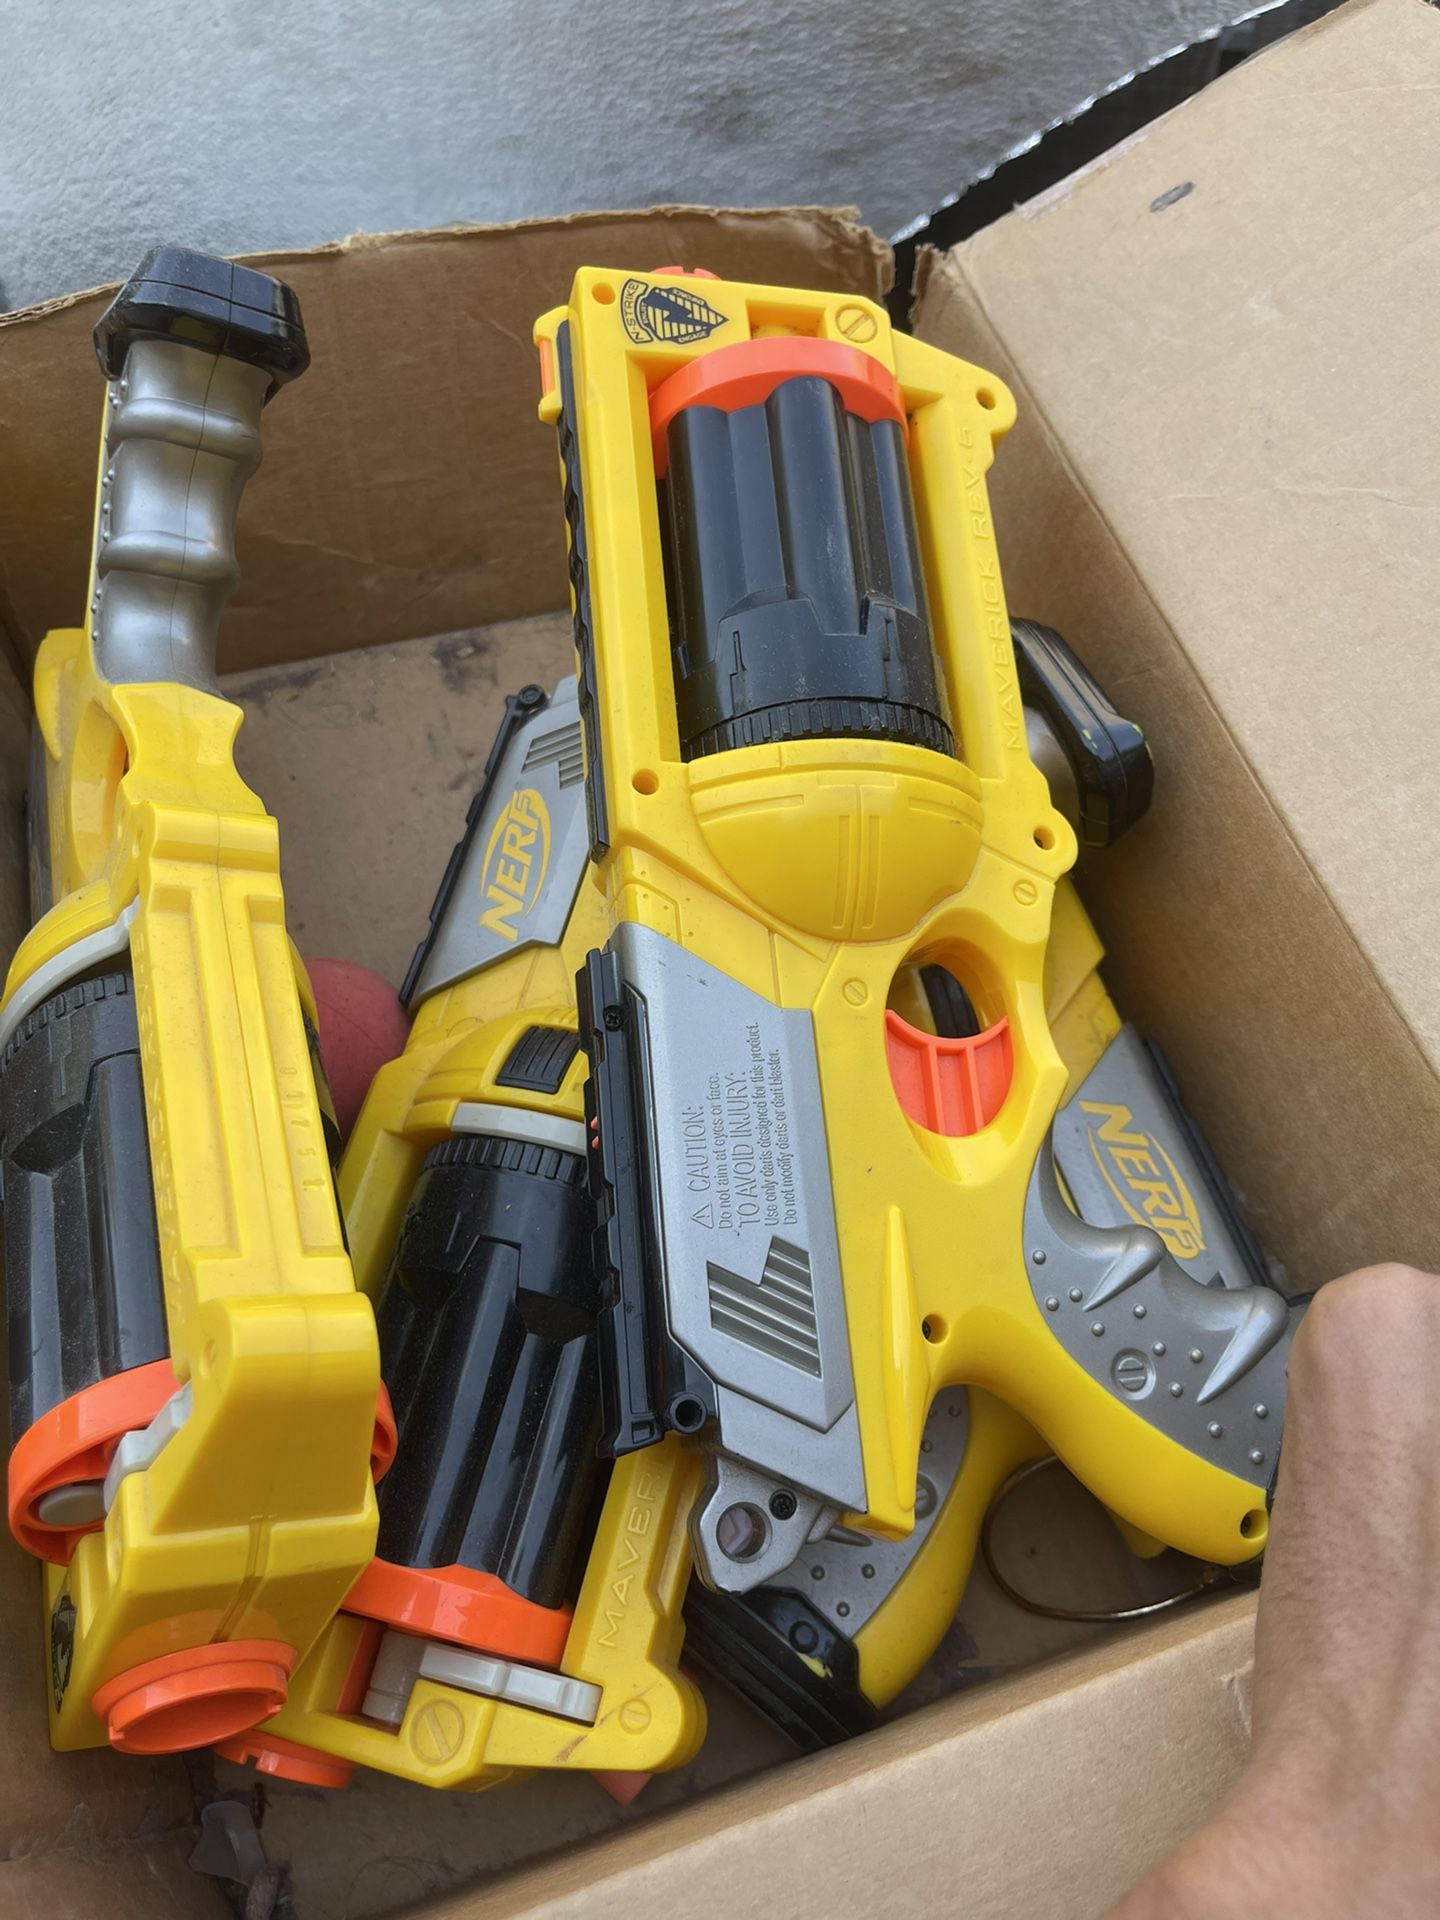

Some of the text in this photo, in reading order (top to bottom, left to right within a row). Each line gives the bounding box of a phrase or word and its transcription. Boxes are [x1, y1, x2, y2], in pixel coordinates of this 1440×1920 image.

[624, 282, 644, 340] N-STRIKE
[977, 557, 1023, 751] MAVERICK
[479, 788, 543, 943] NERF
[682, 1106, 710, 1192] CAUTION:
[706, 1072, 733, 1229] Do not aim at eyes or face.
[724, 1071, 760, 1228] TO AVOID INJURY:
[746, 1022, 779, 1226] Use only darts designed for this product.
[767, 1048, 798, 1225] Do not modify darts or dart blaster.
[1079, 1100, 1206, 1256] NERF
[598, 1472, 661, 1647] MAVER
